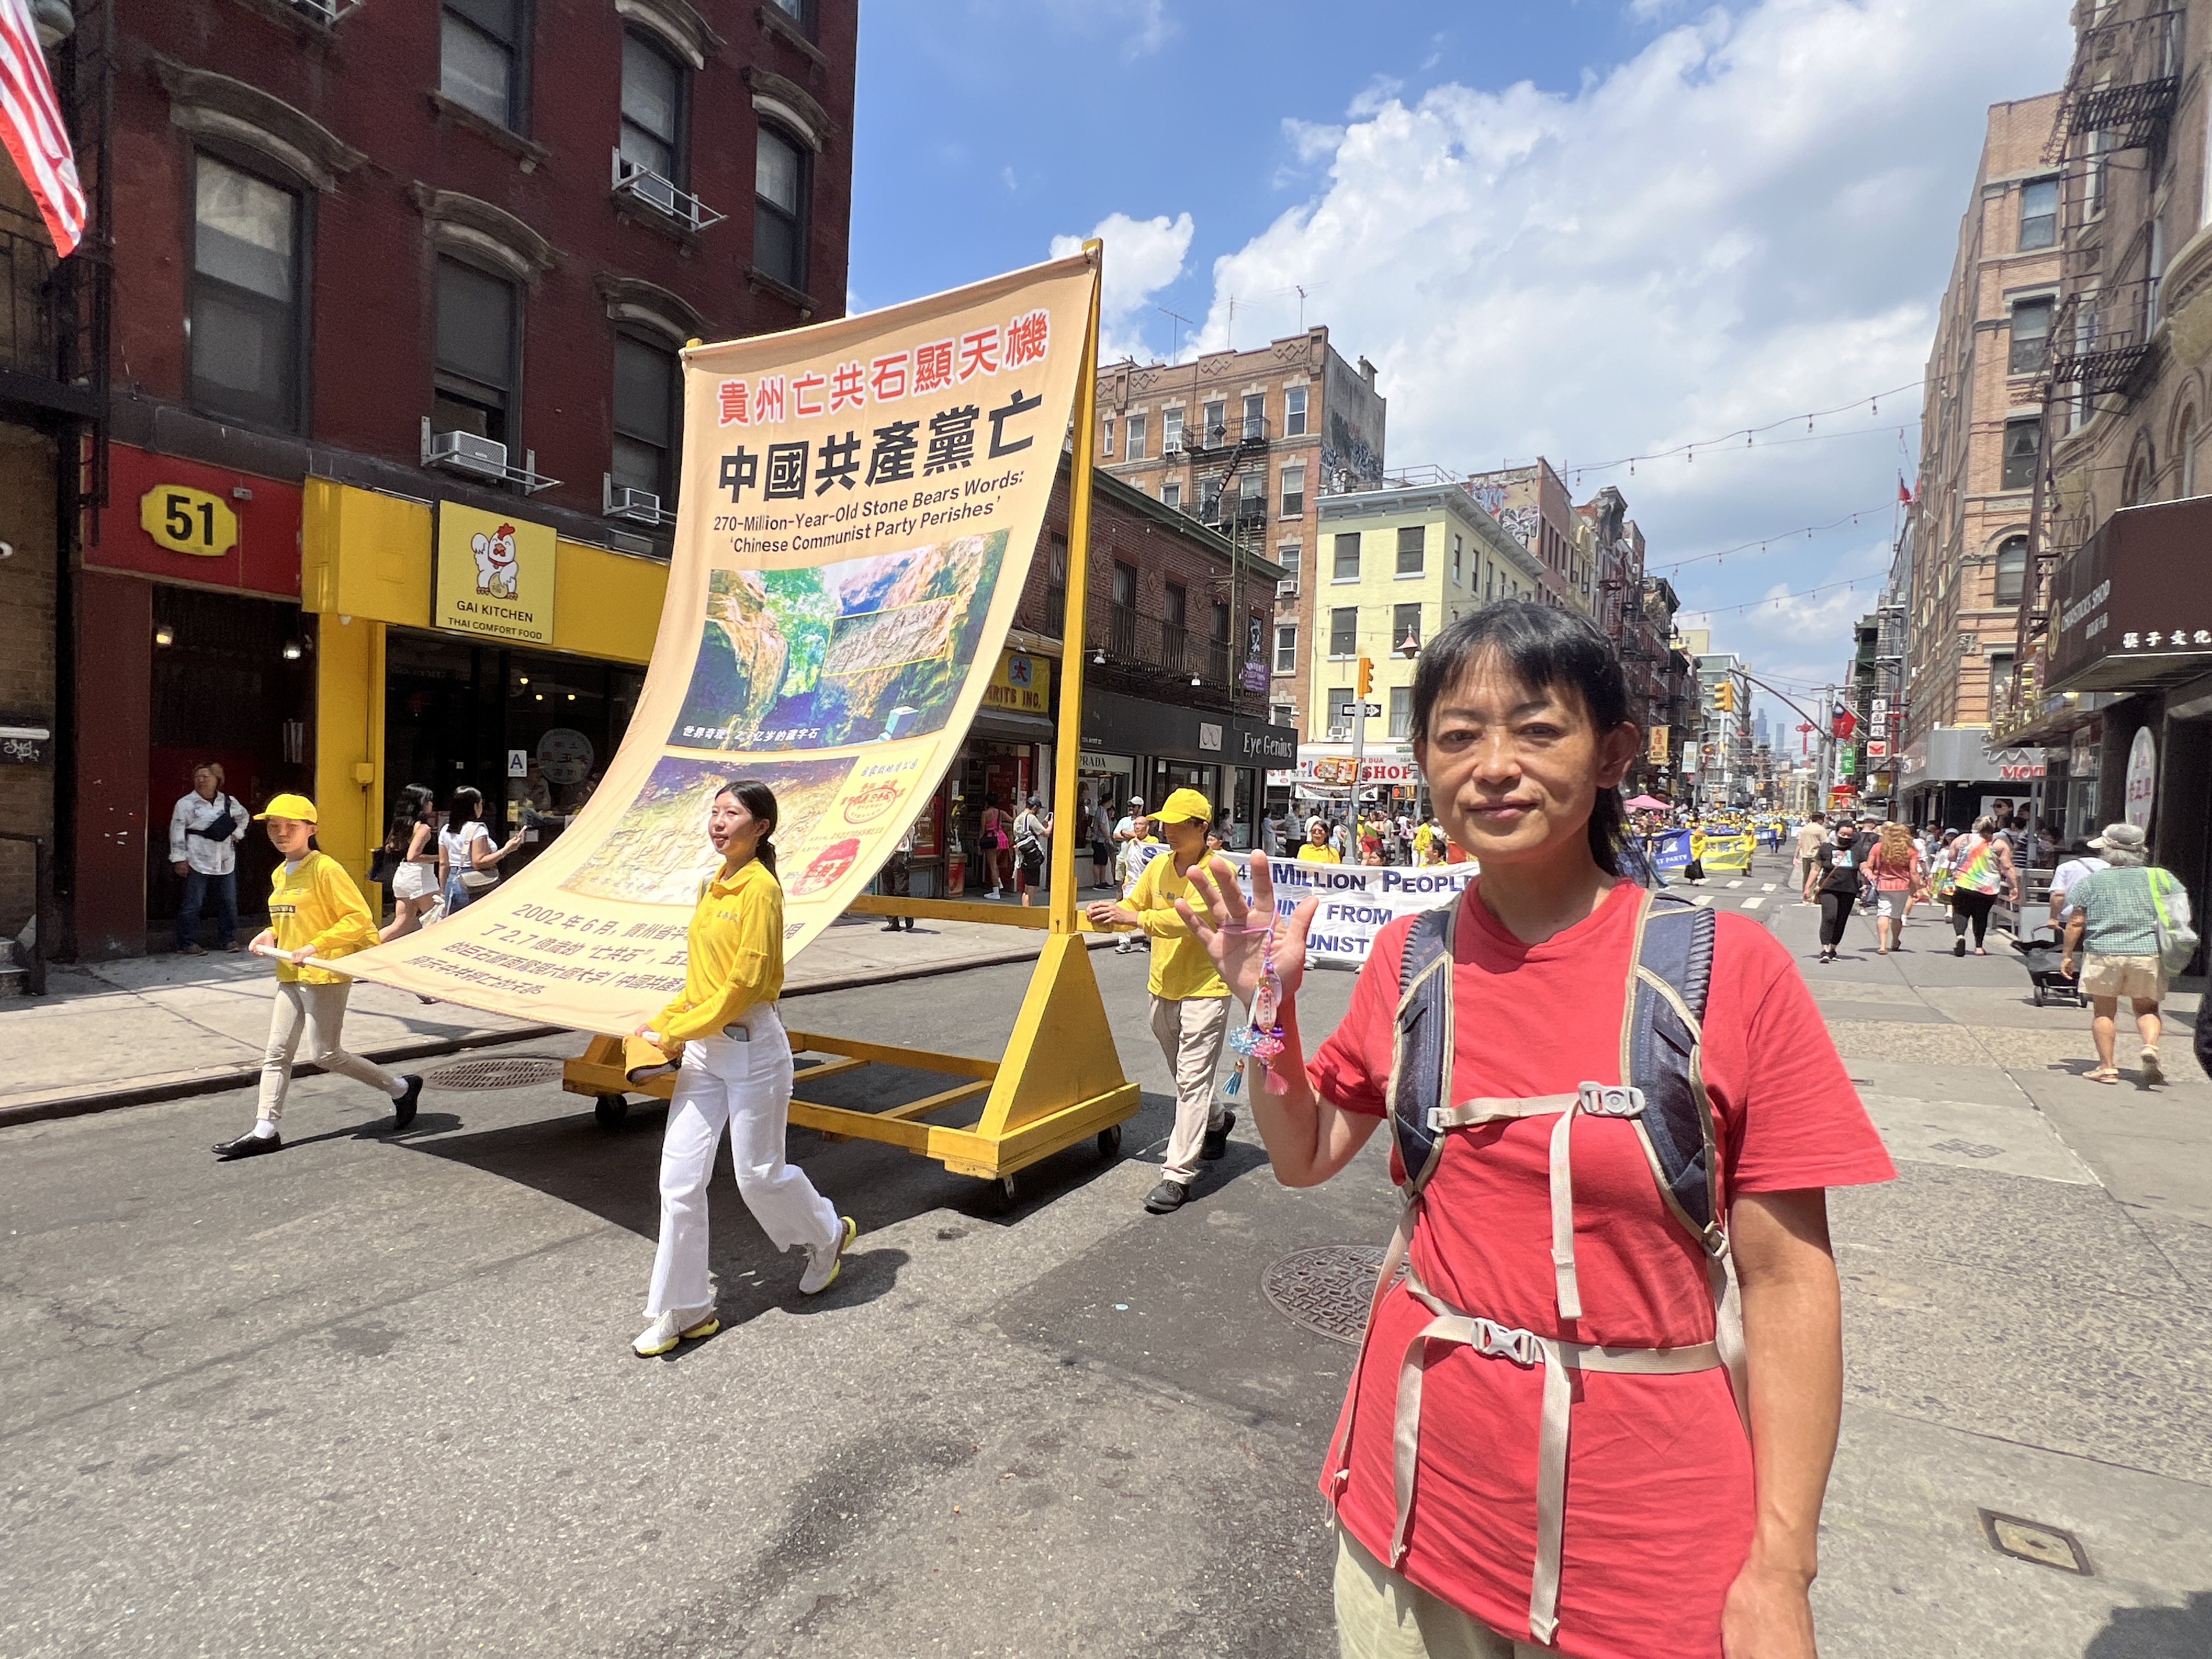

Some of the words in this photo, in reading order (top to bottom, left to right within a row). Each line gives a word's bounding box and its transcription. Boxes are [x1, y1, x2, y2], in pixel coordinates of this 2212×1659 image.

[719, 313, 1048, 425] 貴州亡共石顯天機
[719, 390, 1042, 504] 中國共產黨亡
[713, 503, 857, 531] 270-Million-Year-Old
[862, 500, 908, 518] Stone
[912, 489, 960, 509] Bears
[963, 470, 1025, 496] Words:
[166, 494, 214, 546] 51
[792, 524, 872, 551] Communist
[874, 517, 917, 538] Party
[457, 600, 478, 613] GAI
[482, 605, 533, 623] KITCHEN
[448, 617, 471, 628] THAI
[472, 621, 517, 635] COMFORT
[518, 629, 543, 640] FOOD
[988, 685, 1017, 703] IRITS
[1022, 690, 1041, 708] INC.
[1243, 732, 1261, 758] Eye
[1263, 735, 1293, 758] Genius
[509, 753, 523, 769] A
[1272, 863, 1366, 891] MILLION
[1382, 870, 1473, 893] PEOPL
[511, 903, 566, 926] 2002
[1327, 904, 1392, 926] FROM
